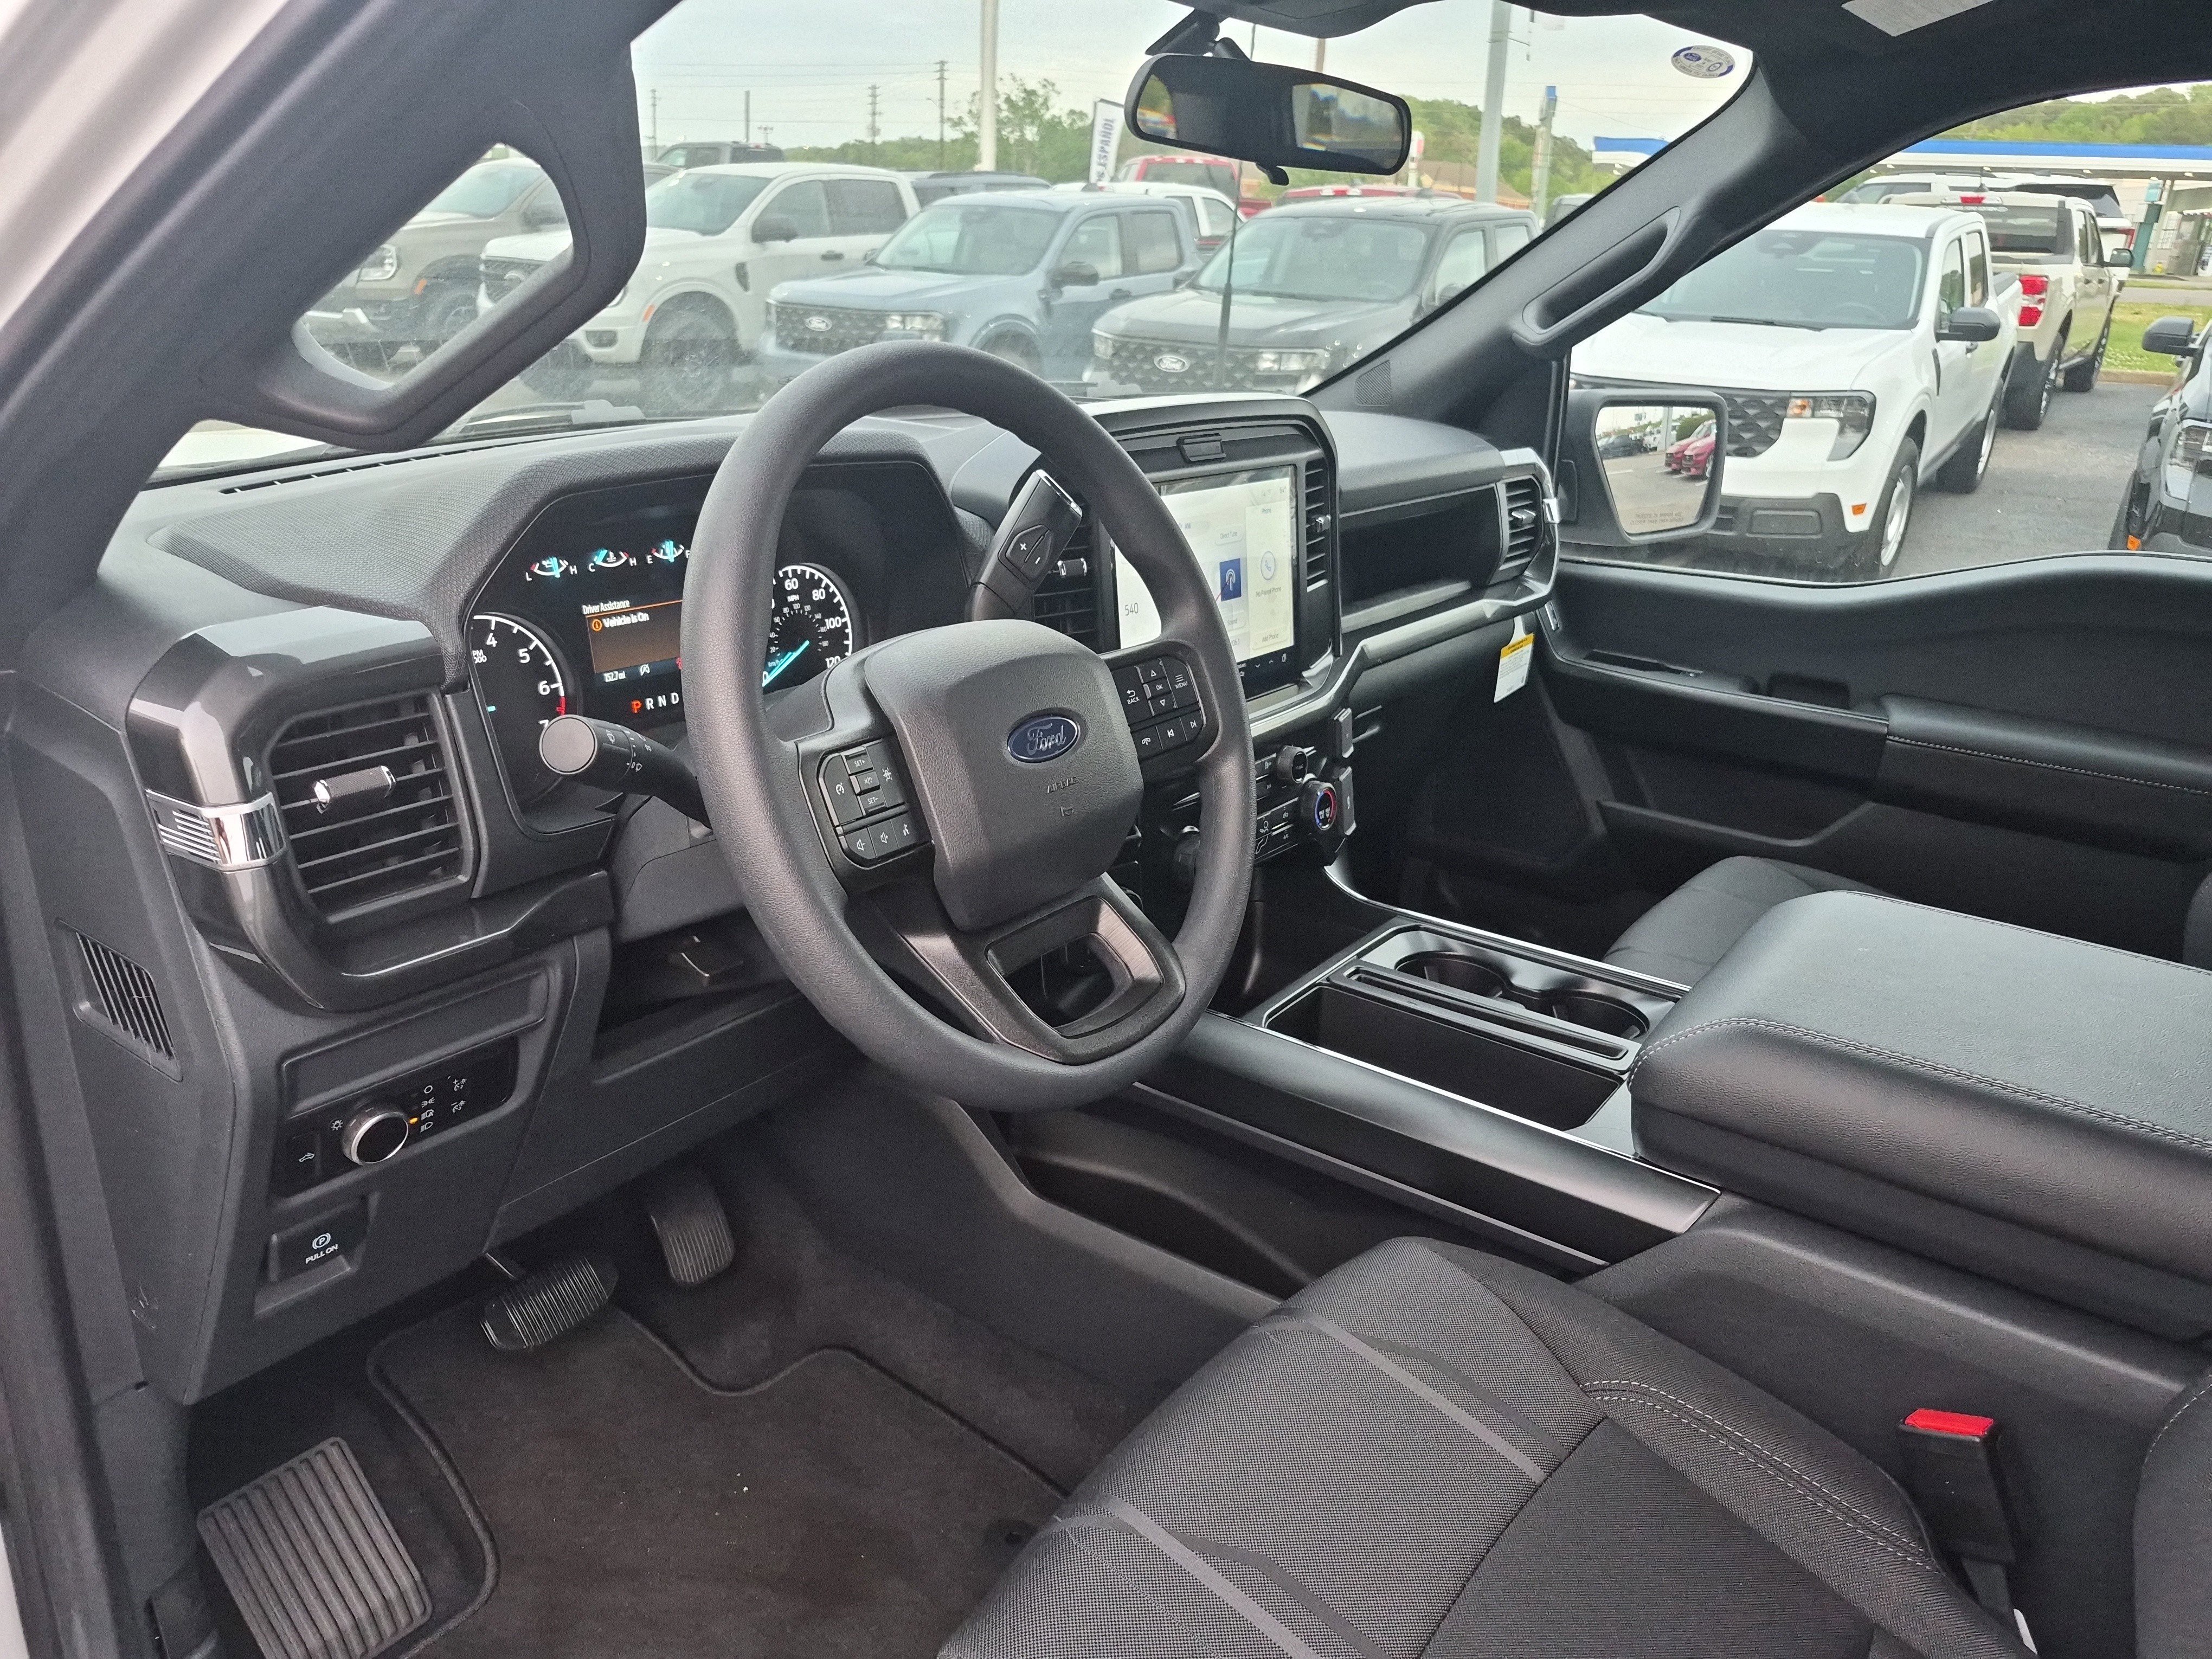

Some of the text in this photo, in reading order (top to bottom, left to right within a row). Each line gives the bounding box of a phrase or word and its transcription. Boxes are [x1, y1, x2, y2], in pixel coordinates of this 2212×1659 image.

[588, 557, 637, 573] C H
[646, 555, 653, 565] E
[526, 565, 577, 581] L H
[785, 577, 799, 590] 60
[787, 594, 800, 602] MPH
[812, 588, 826, 601] 80
[582, 600, 631, 615] Driver Assistance
[1124, 602, 1139, 617] 540
[602, 614, 631, 628] Vehicle
[637, 612, 650, 622] On
[825, 616, 841, 629] 100
[486, 632, 498, 647] 4
[472, 649, 484, 657] PM
[519, 648, 530, 664] 5
[603, 671, 626, 683] 152.7 mi
[538, 680, 550, 696] 6
[1175, 681, 1188, 690] MENU
[631, 692, 679, 713] P R N D
[1127, 696, 1140, 705] BACK
[1027, 723, 1066, 755] Ford
[305, 1244, 339, 1264] PULL ON
